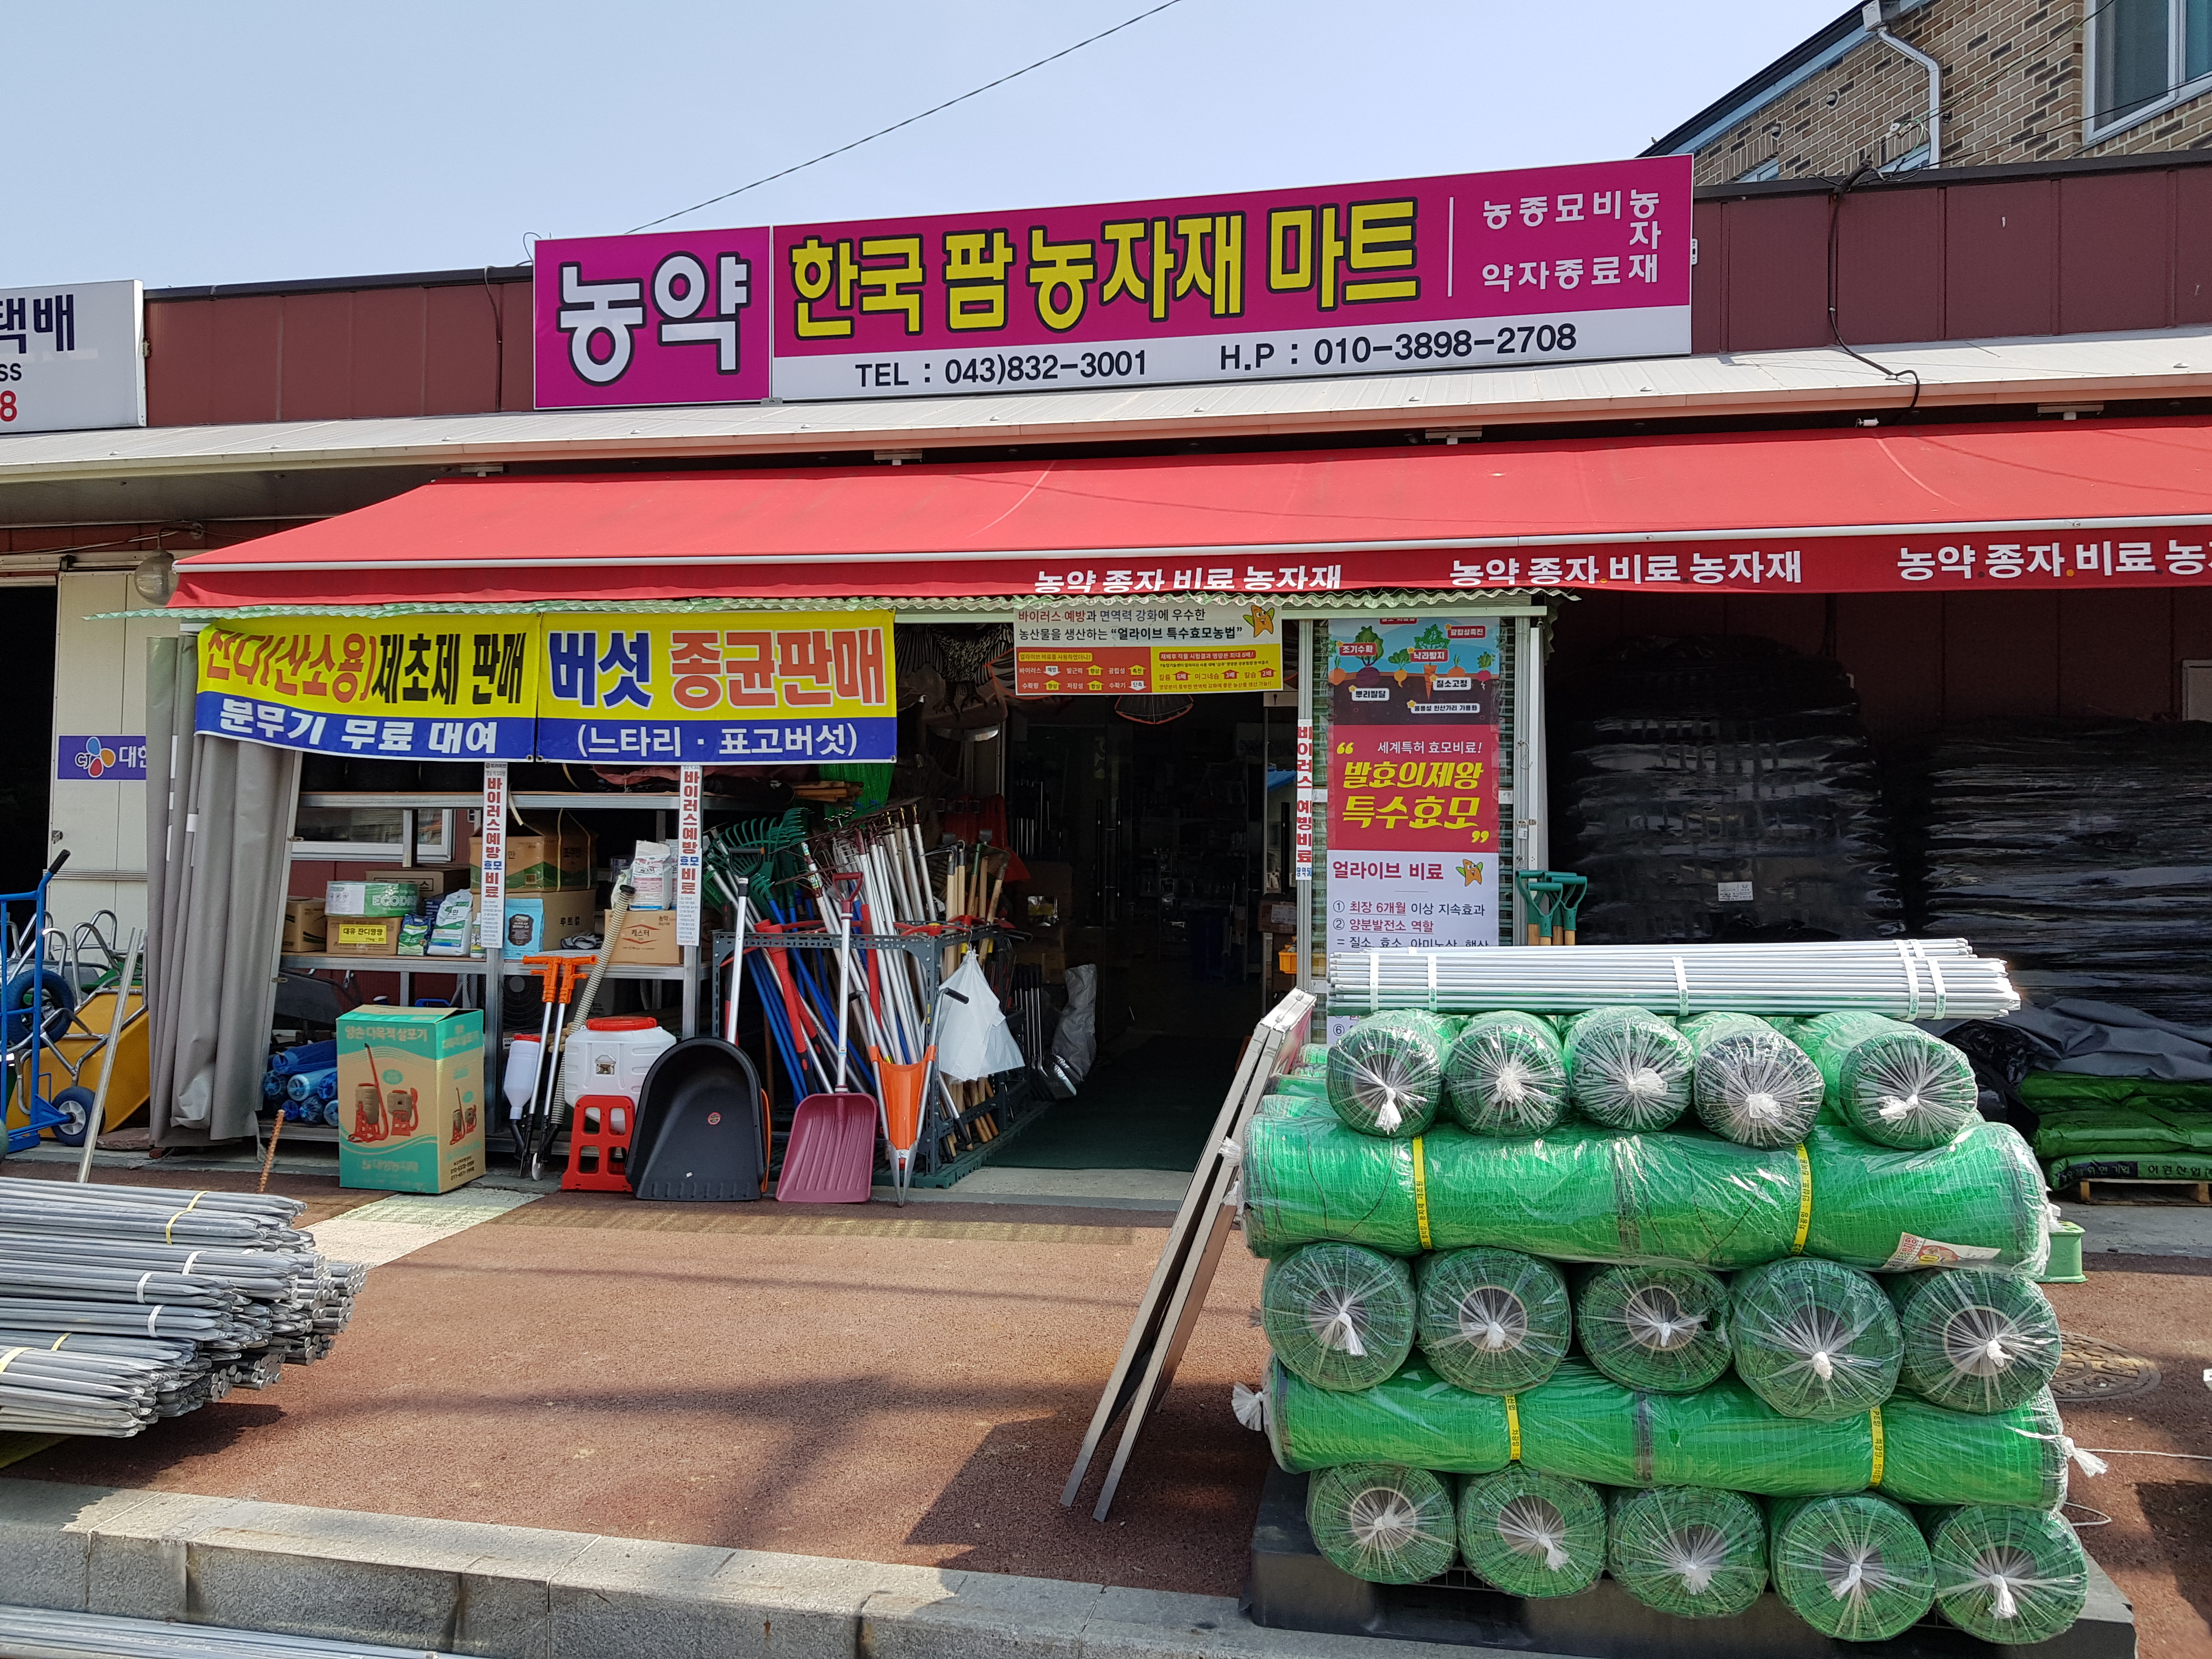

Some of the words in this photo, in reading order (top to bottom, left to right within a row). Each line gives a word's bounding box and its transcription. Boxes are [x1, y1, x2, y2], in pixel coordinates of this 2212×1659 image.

[789, 234, 926, 340] 한국
[1267, 197, 1420, 312] 마트
[557, 251, 751, 387] 농약
[1220, 342, 1275, 371] H.P
[1314, 323, 1577, 366] 010-3898-2708
[855, 363, 909, 387] TEL
[945, 349, 1146, 385] 043)832-3001
[1449, 557, 1520, 586] 농약
[1527, 556, 1599, 585] 종자
[1609, 554, 1681, 584] 비료
[1689, 550, 1802, 584] 농자재
[1897, 545, 1976, 581] 농약
[1985, 542, 2066, 578] 종자
[2075, 540, 2157, 577] 비료
[1034, 571, 1096, 594] 농약
[1103, 569, 1165, 592] 종자
[1173, 567, 1235, 590] 비료
[1243, 563, 1342, 590] 농자재
[1018, 610, 1061, 623] 바이러스
[1064, 610, 1097, 623] 예방과
[1100, 610, 1132, 622] 면역력
[1136, 608, 1169, 622] 강화에
[1172, 608, 1205, 622] 우수한
[1019, 628, 1062, 641] 농산물을
[1064, 628, 1108, 641] 생산하는
[1342, 645, 1373, 653] 조기수확
[1413, 651, 1444, 660] 낙과방지
[472, 632, 527, 705] 판매
[548, 629, 654, 710] 버섯
[1355, 690, 1386, 698] 뿌리발달
[1436, 680, 1468, 688] 질소고정
[219, 697, 329, 746] 분무기
[341, 719, 413, 752] 무료
[428, 721, 498, 754] 대여
[577, 723, 681, 757] (느타리
[718, 722, 858, 757] 표고버섯)
[1377, 741, 1425, 754] 세계특허
[1428, 741, 1482, 754] 효모비료!
[1343, 761, 1484, 790] 발효의제왕
[1342, 795, 1480, 830] 특수효모
[484, 860, 503, 871] 효모
[680, 856, 699, 866] 효모
[1332, 861, 1402, 879] 얼라이브
[1409, 862, 1444, 880] 비료
[485, 872, 499, 898] 비료
[681, 868, 696, 895] 비료
[1349, 901, 1373, 914] 최장
[1376, 901, 1407, 915] 6개월
[1411, 902, 1434, 915] 이상
[1438, 903, 1485, 917] 지속효과
[1349, 918, 1407, 932] 양분발전소
[1410, 919, 1434, 933] 역할
[345, 1025, 364, 1040] 양손
[366, 1026, 396, 1041] 다목적
[397, 1028, 427, 1042] 살포기
[1872, 1410, 1882, 1427] PE망
